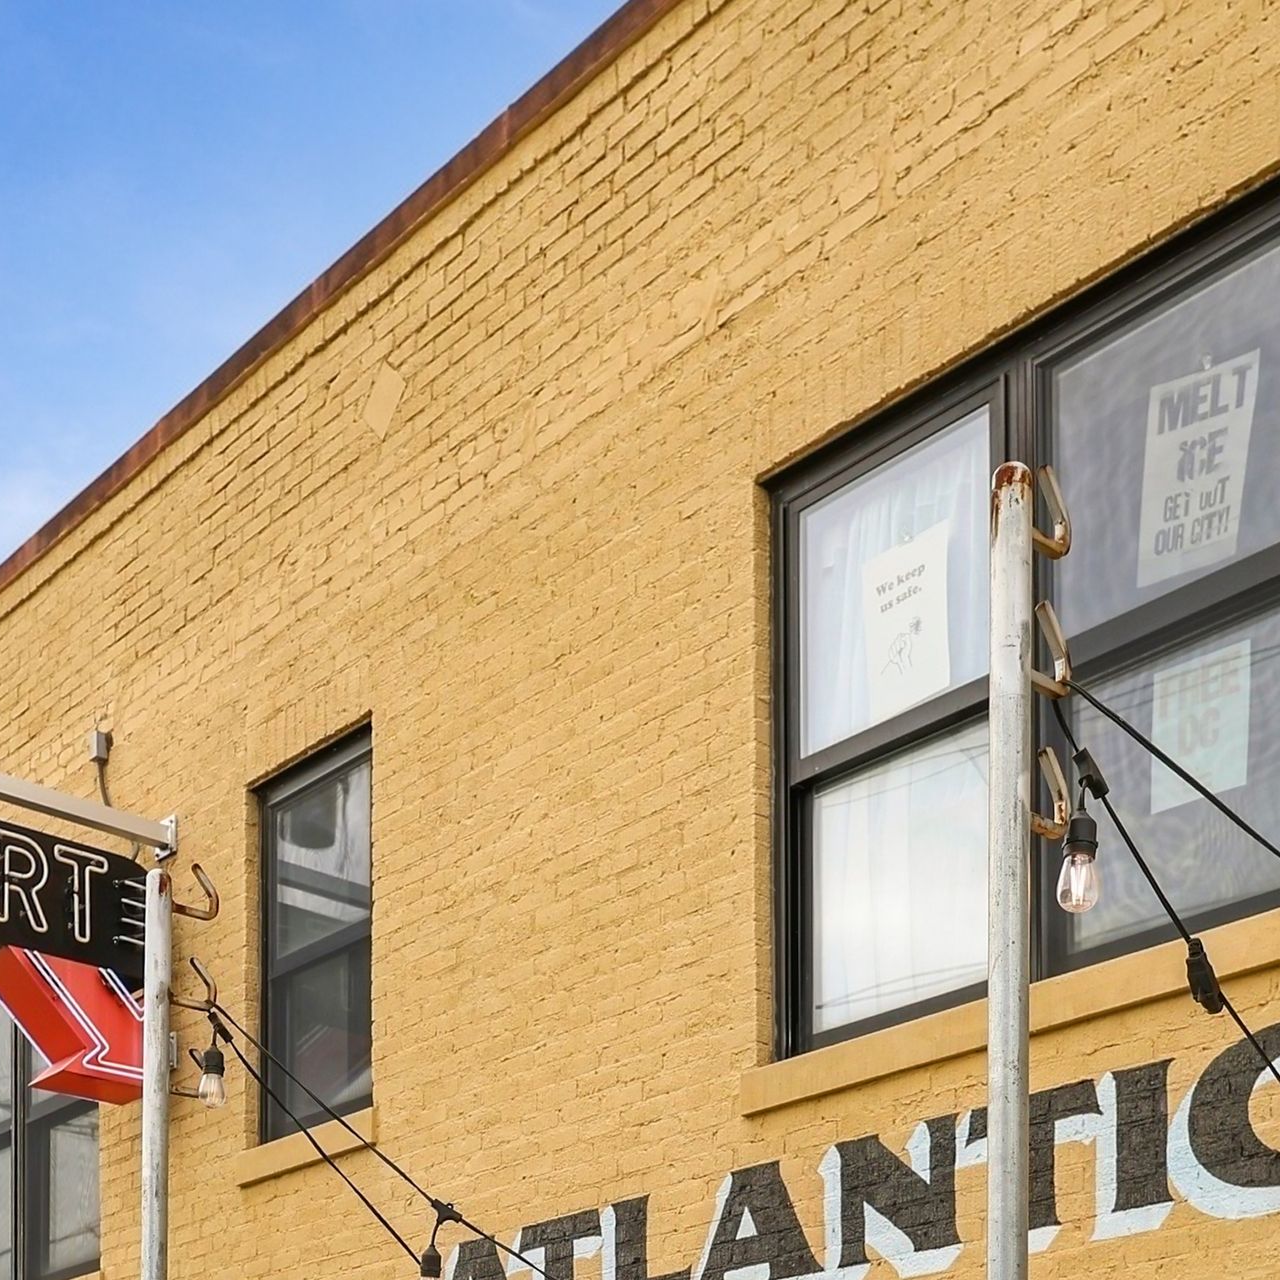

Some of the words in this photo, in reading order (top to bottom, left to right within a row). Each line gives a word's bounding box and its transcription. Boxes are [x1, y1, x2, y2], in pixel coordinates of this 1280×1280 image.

[1157, 364, 1252, 435] MELT
[1154, 522, 1185, 556] OUR
[875, 580, 895, 597] We
[896, 563, 926, 587] keep
[879, 599, 894, 613] us
